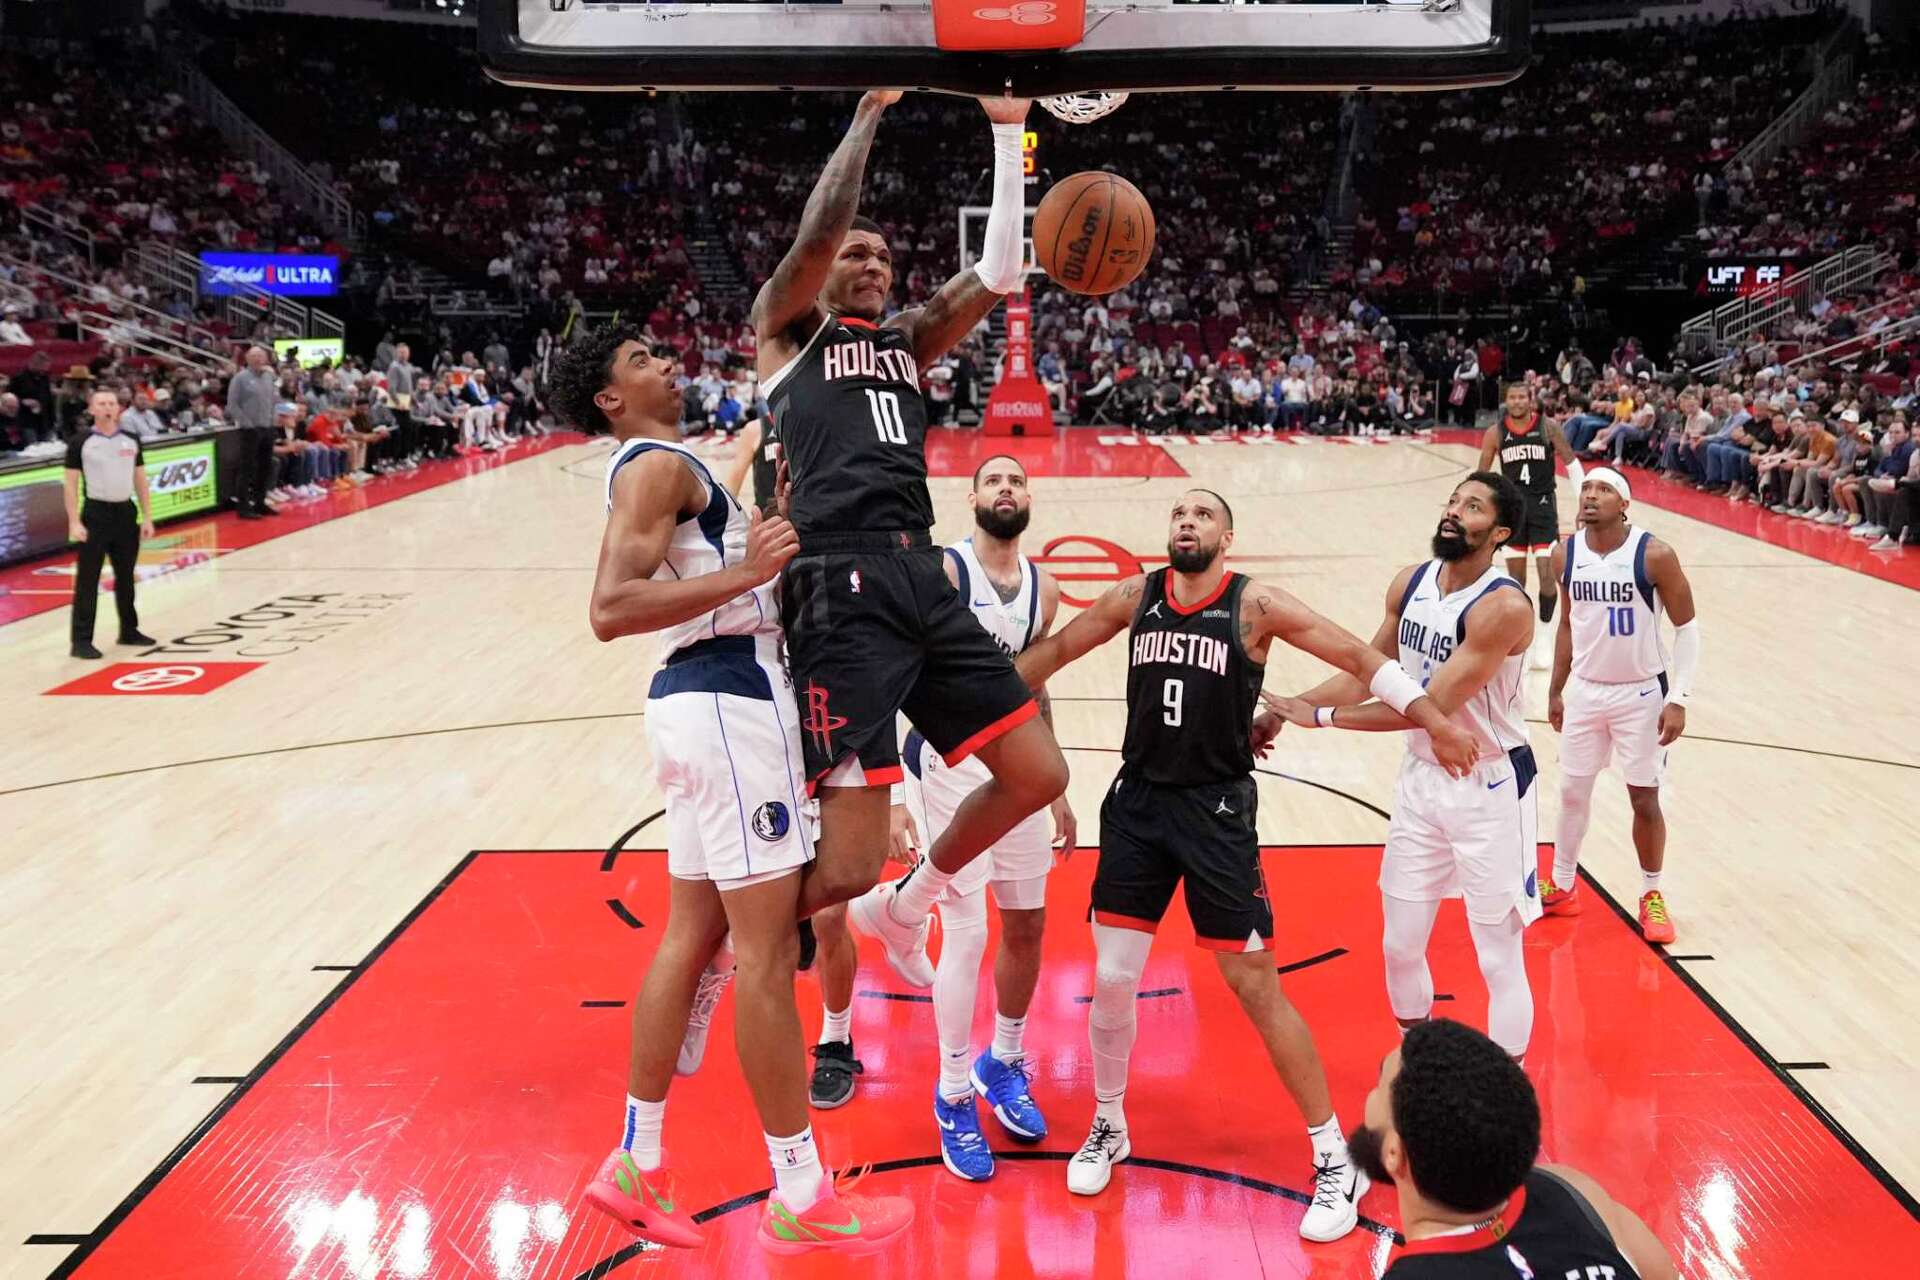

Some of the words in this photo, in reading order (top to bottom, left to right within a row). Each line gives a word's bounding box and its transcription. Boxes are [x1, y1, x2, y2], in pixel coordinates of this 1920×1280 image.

[1062, 205, 1103, 281] Wilson
[277, 267, 333, 284] ULTRA
[824, 340, 921, 395] HOUSTON
[865, 388, 908, 445] 10
[153, 459, 208, 488] URO
[1501, 444, 1546, 464] HOUSTON
[1519, 463, 1531, 485] 4
[171, 484, 209, 506] TIRES
[1572, 581, 1633, 603] DALLAS
[136, 593, 343, 657] TOYOTA
[236, 593, 414, 657] CENTER
[1400, 618, 1453, 663] DALAS
[1607, 606, 1635, 637] 10
[1132, 631, 1228, 676] HOUSTON
[1163, 678, 1184, 727] 9
